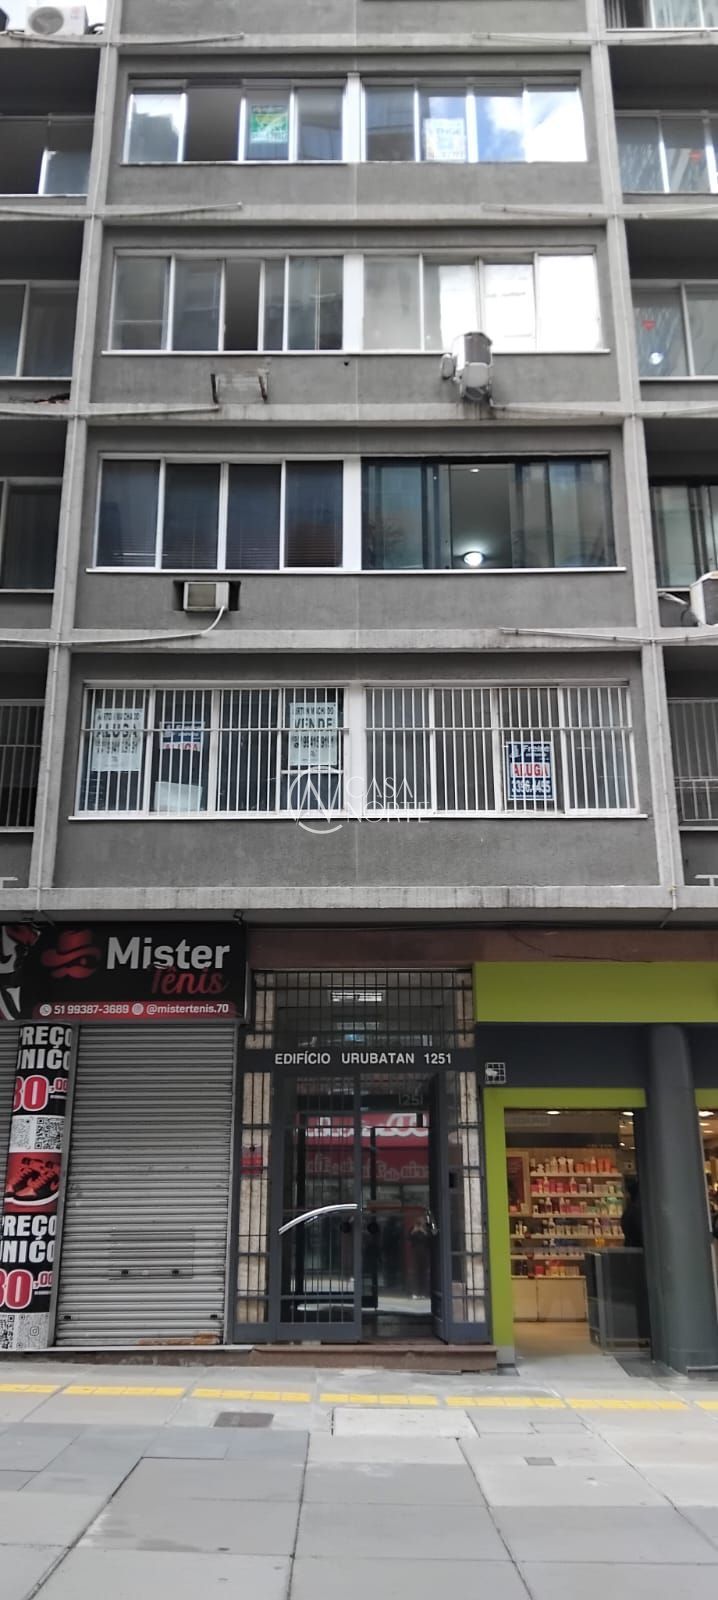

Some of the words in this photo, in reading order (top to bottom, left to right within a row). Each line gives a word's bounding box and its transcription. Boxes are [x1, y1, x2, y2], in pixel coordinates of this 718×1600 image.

[512, 763, 549, 777] ALUGA
[106, 936, 230, 970] Mister
[151, 966, 229, 995] Tênis
[53, 1004, 65, 1015] 51
[146, 1003, 229, 1015] @mistertenis.70
[275, 1050, 331, 1065] EDIFÍCIO
[341, 1052, 415, 1065] URUBATAN
[424, 1052, 452, 1065] 1251
[1, 1215, 57, 1240] REÇO
